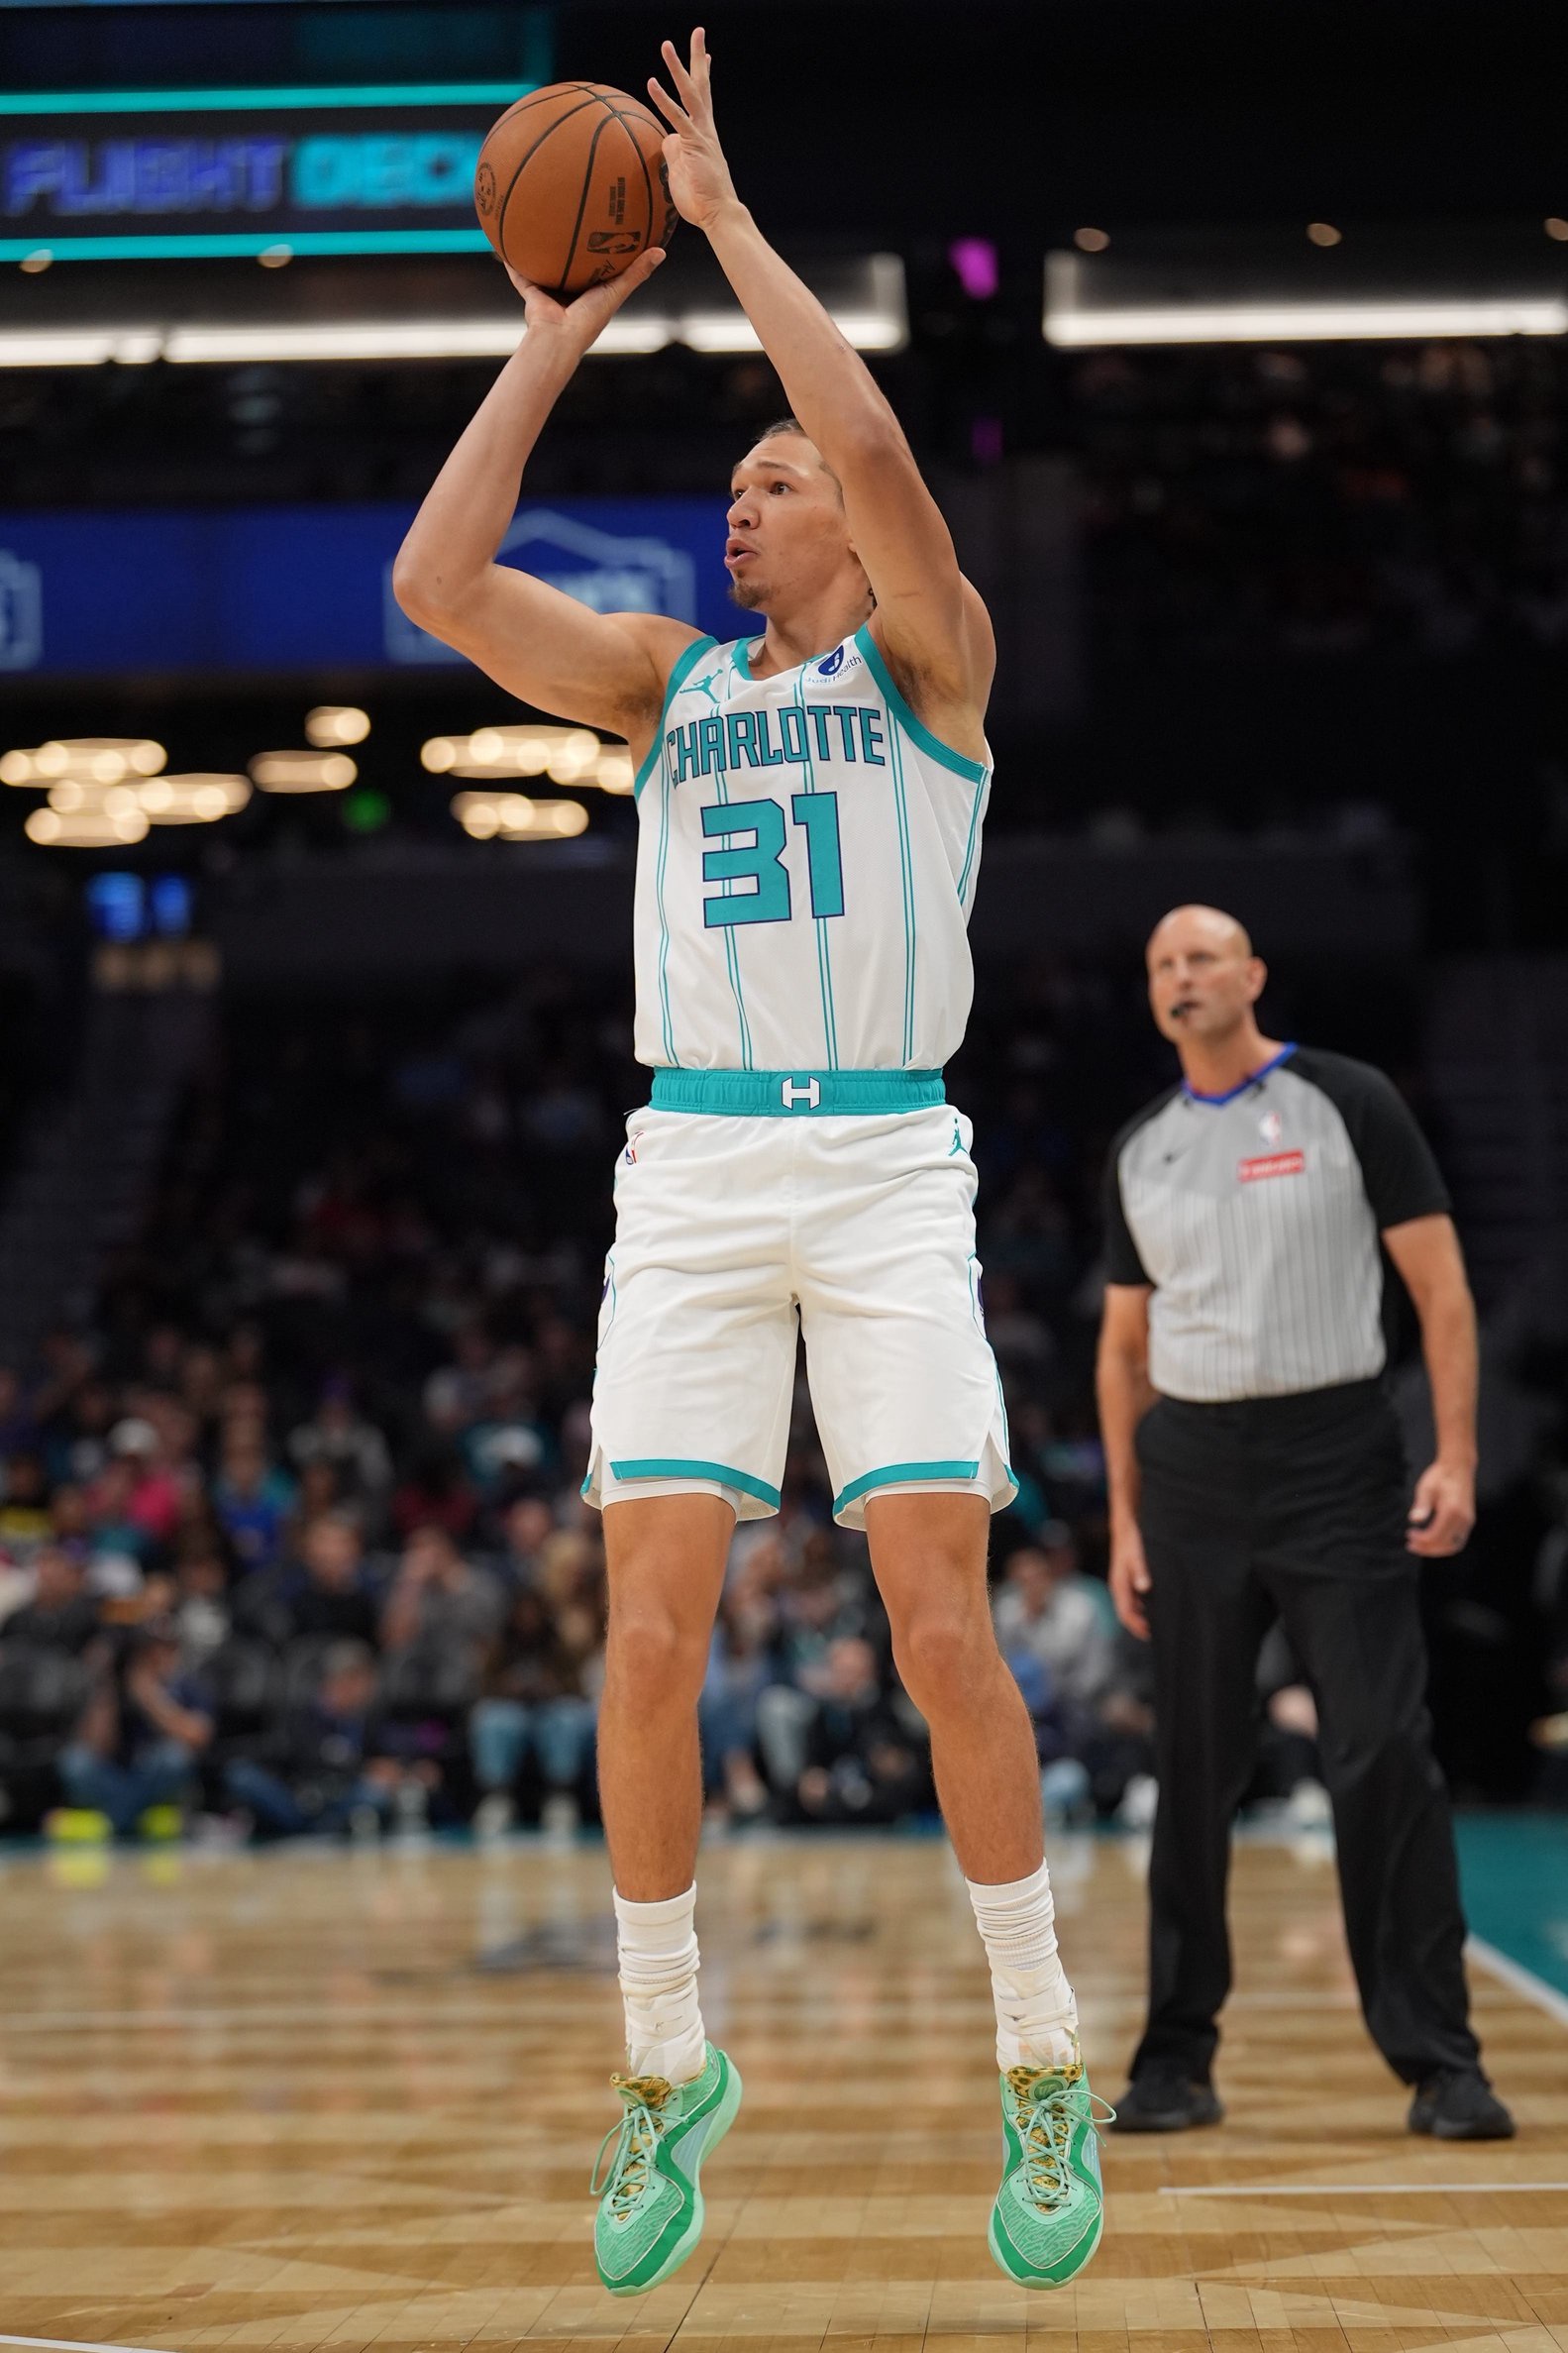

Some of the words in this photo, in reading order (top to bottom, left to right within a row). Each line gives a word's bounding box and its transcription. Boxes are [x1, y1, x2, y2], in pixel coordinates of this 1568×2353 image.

[5, 137, 286, 216] FLIGHT
[832, 656, 863, 682] Health
[666, 705, 886, 789] CHARLOTTE
[699, 791, 846, 929] 31
